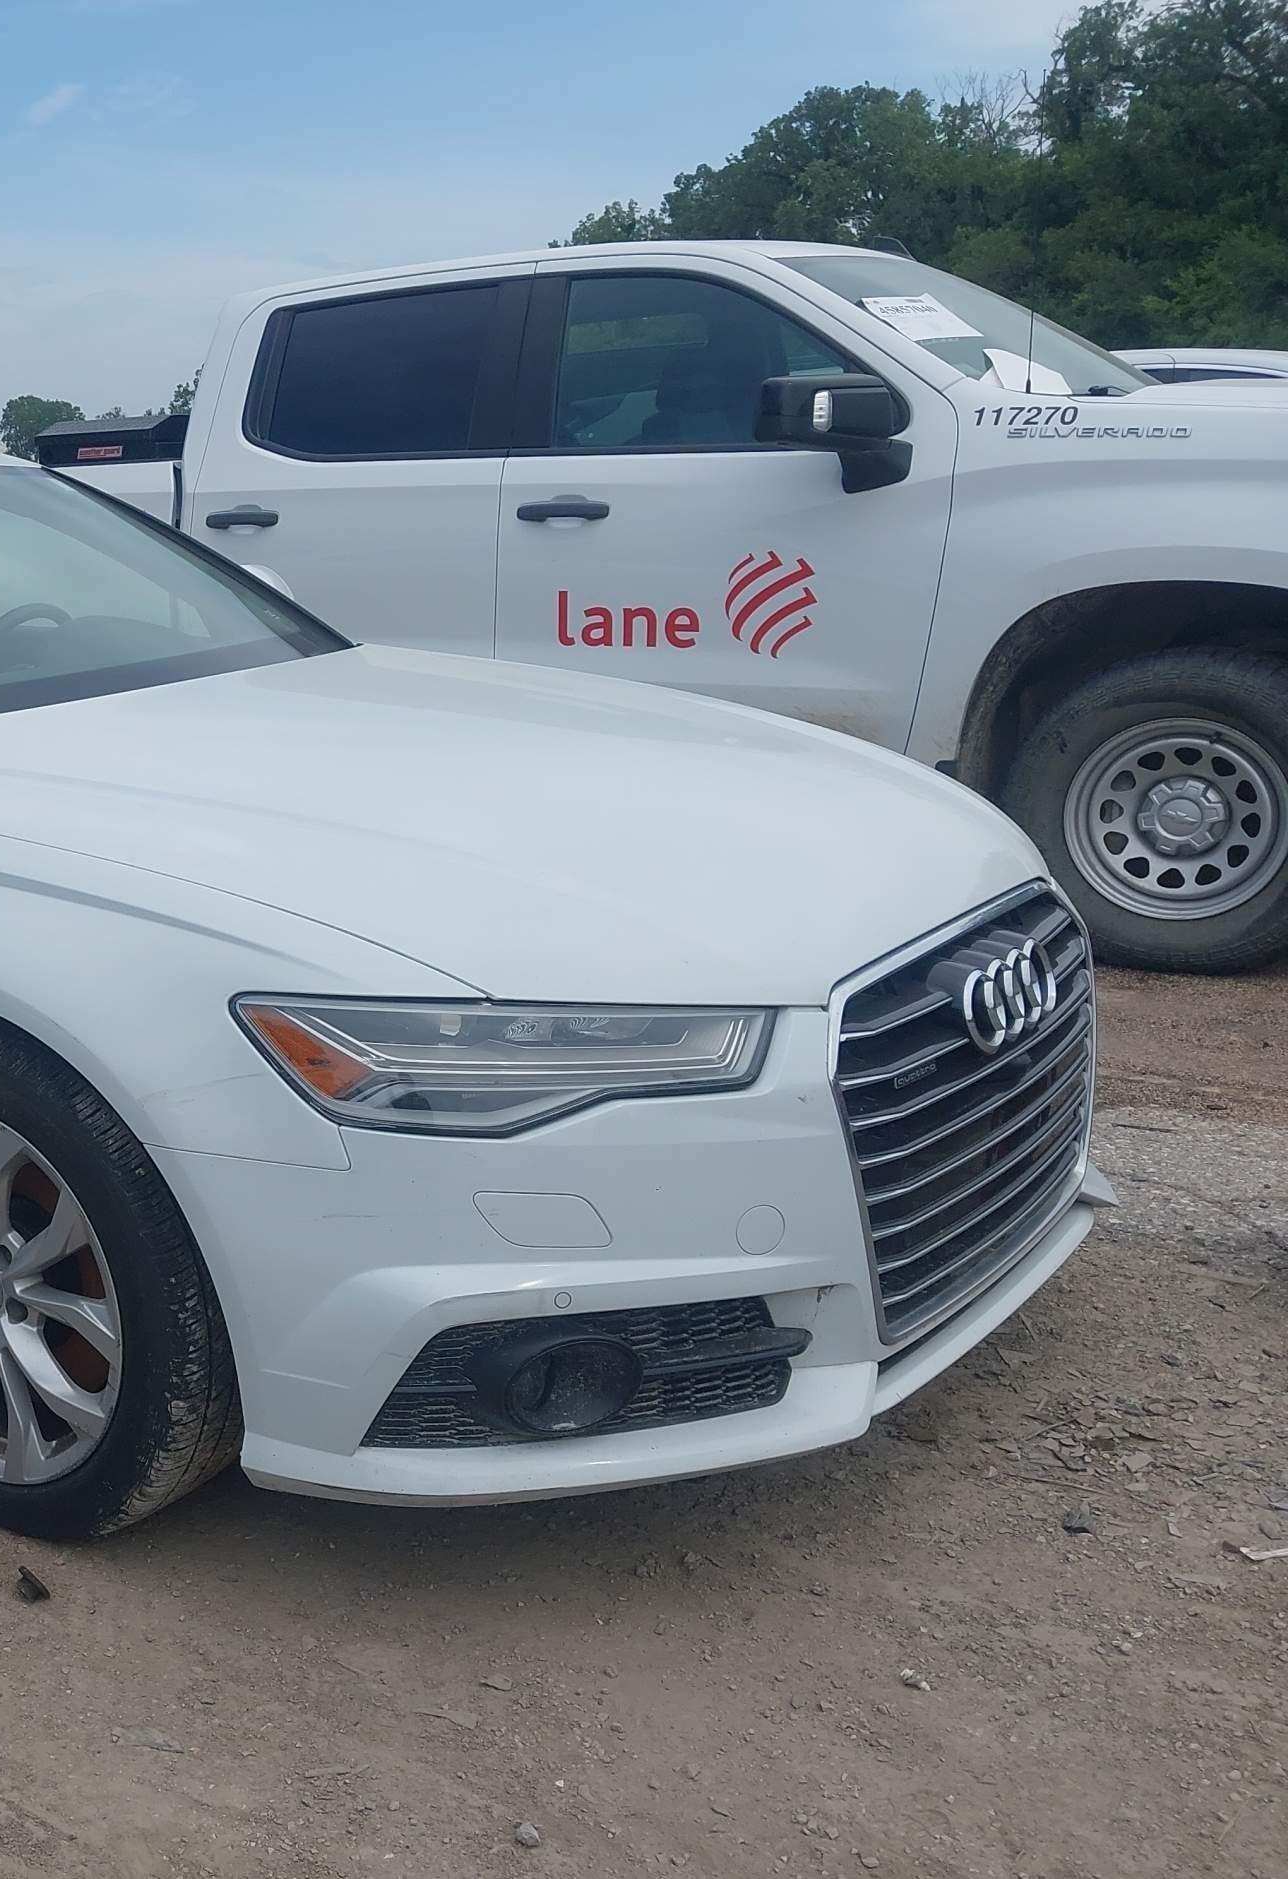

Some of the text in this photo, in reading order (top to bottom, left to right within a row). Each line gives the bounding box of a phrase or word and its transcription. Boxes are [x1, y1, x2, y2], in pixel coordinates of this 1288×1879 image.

[974, 406, 1078, 426] 117270
[1007, 426, 1193, 438] SILVERADO
[558, 590, 700, 648] lane
[897, 1063, 936, 1087] quattro
